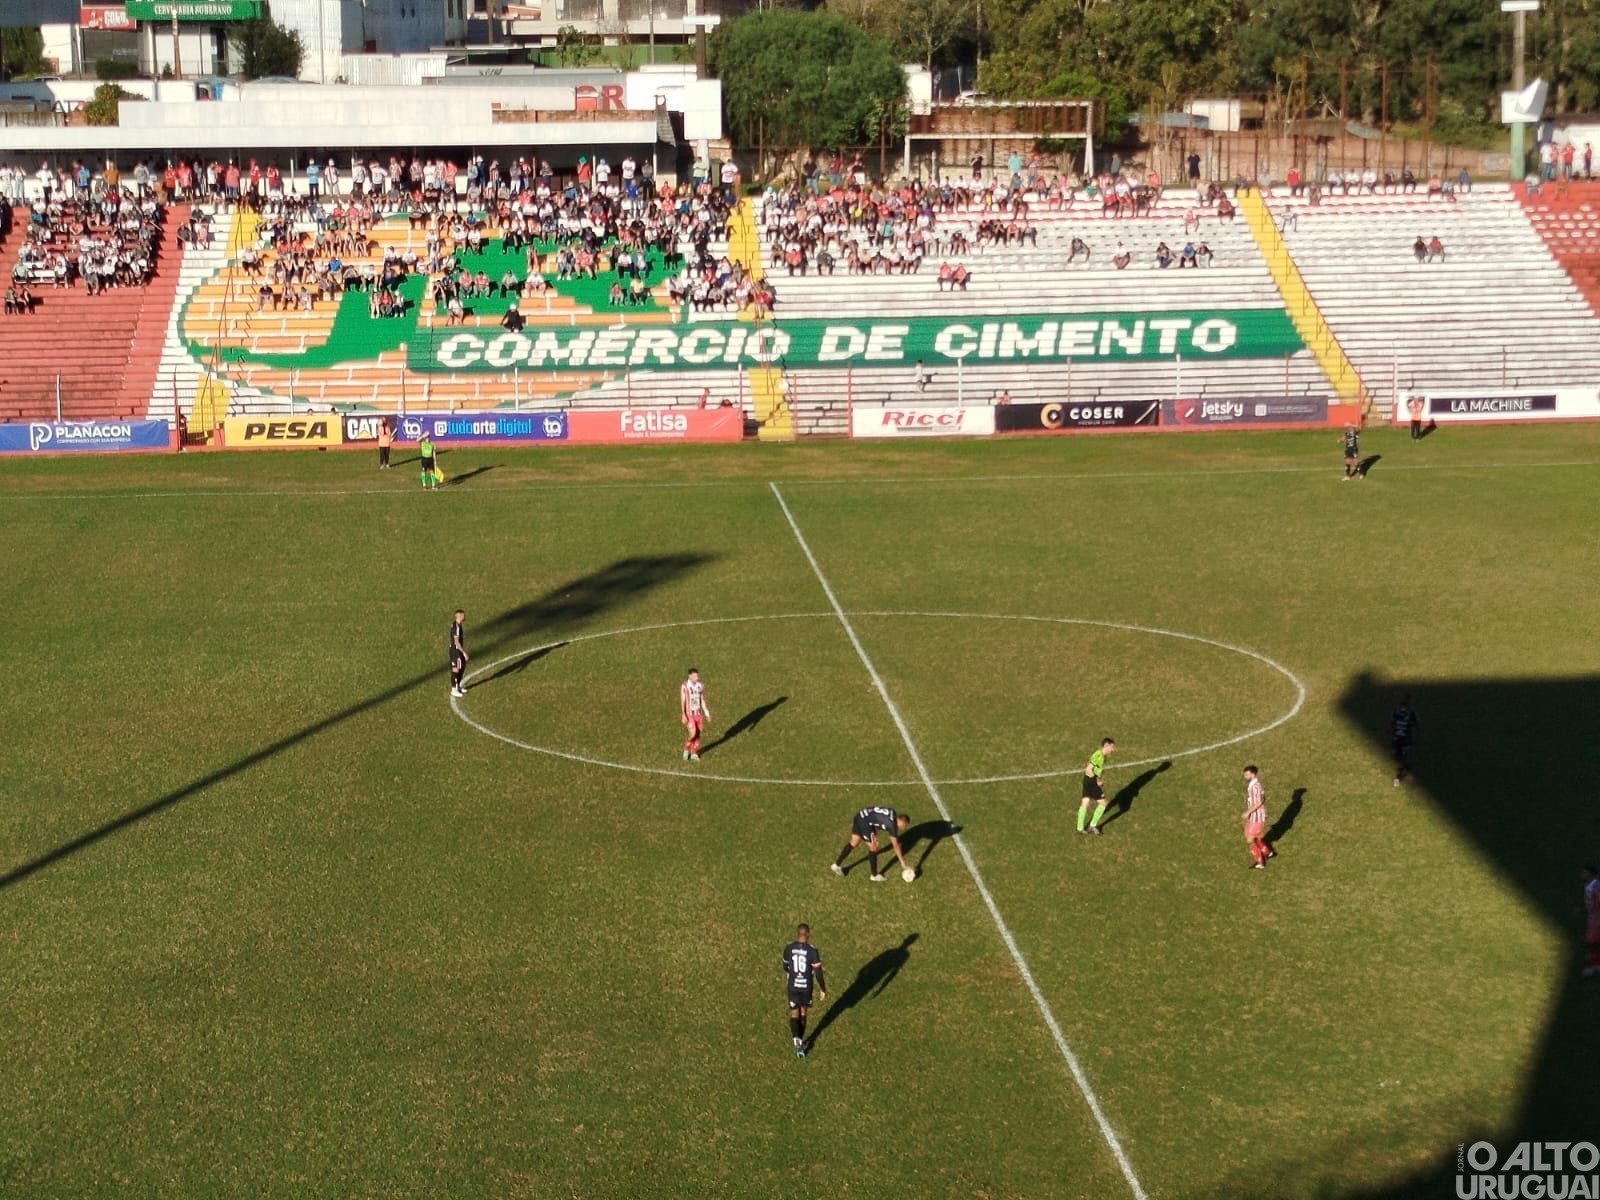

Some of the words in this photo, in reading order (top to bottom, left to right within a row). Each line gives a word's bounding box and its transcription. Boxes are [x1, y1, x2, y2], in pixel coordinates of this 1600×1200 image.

[154, 5, 194, 15] CERVARIA
[436, 324, 791, 368] COMÉRCIO
[818, 325, 909, 361] DE
[933, 318, 1237, 358] CIMENTO
[1070, 407, 1124, 420] COSER
[1201, 401, 1244, 417] jetsky
[1451, 400, 1465, 412] LA
[1469, 399, 1532, 412] MACHINE
[620, 411, 688, 432] Fatisa
[882, 410, 966, 426] Ricci
[56, 425, 131, 438] PLANACON
[244, 421, 328, 440] PESA
[347, 417, 379, 439] CAT
[434, 418, 532, 437] @tudoartedigital
[792, 954, 807, 973] 16
